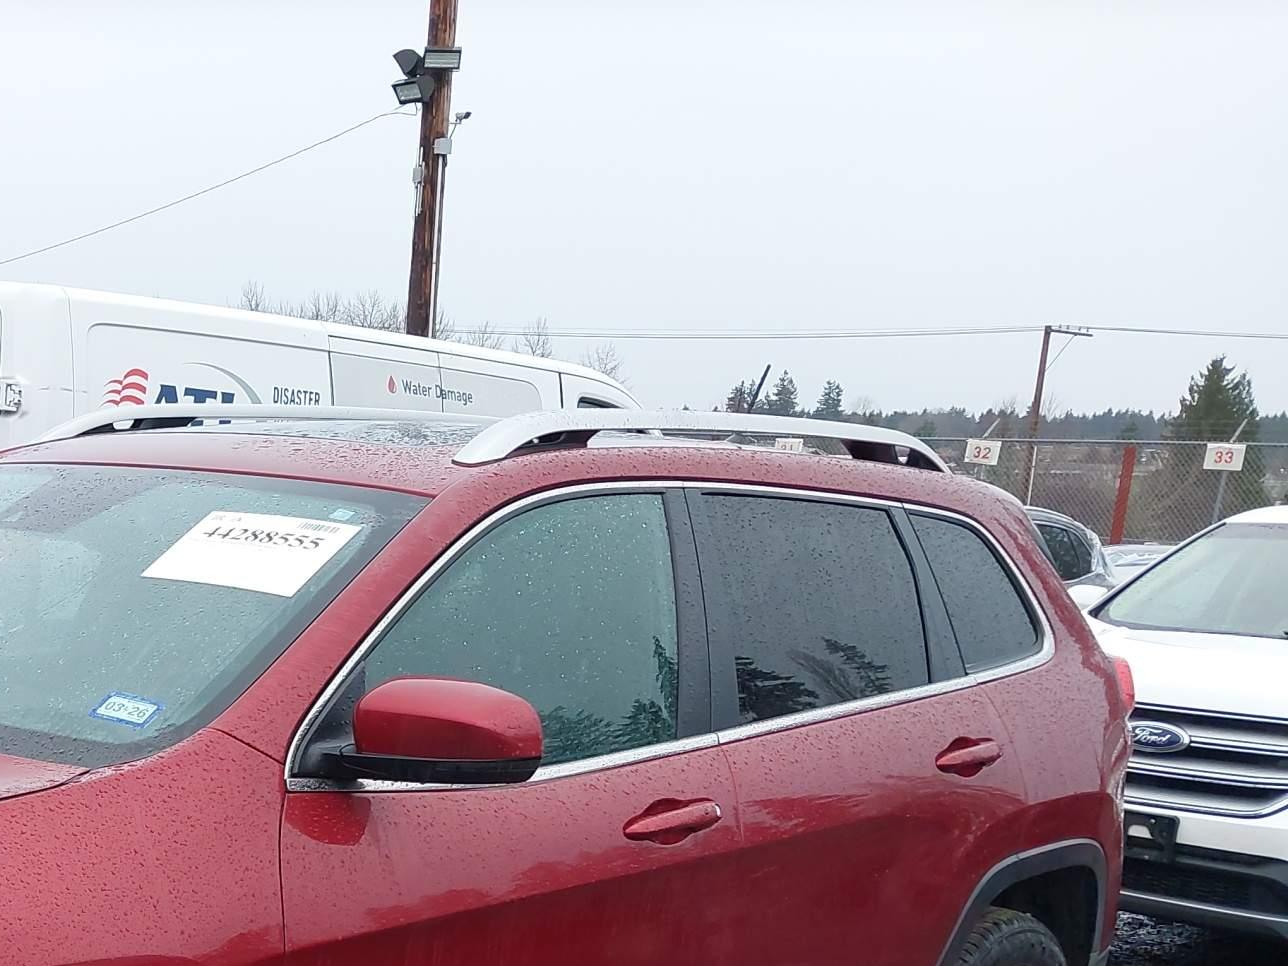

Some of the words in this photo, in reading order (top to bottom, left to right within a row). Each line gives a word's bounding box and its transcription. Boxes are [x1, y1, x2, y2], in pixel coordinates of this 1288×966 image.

[272, 386, 321, 406] DISASTER
[401, 379, 432, 398] Water
[434, 384, 473, 406] Damage
[973, 446, 992, 460] 32
[1214, 450, 1234, 464] 33
[202, 526, 326, 550] 44288555
[1134, 726, 1172, 745] Ford
